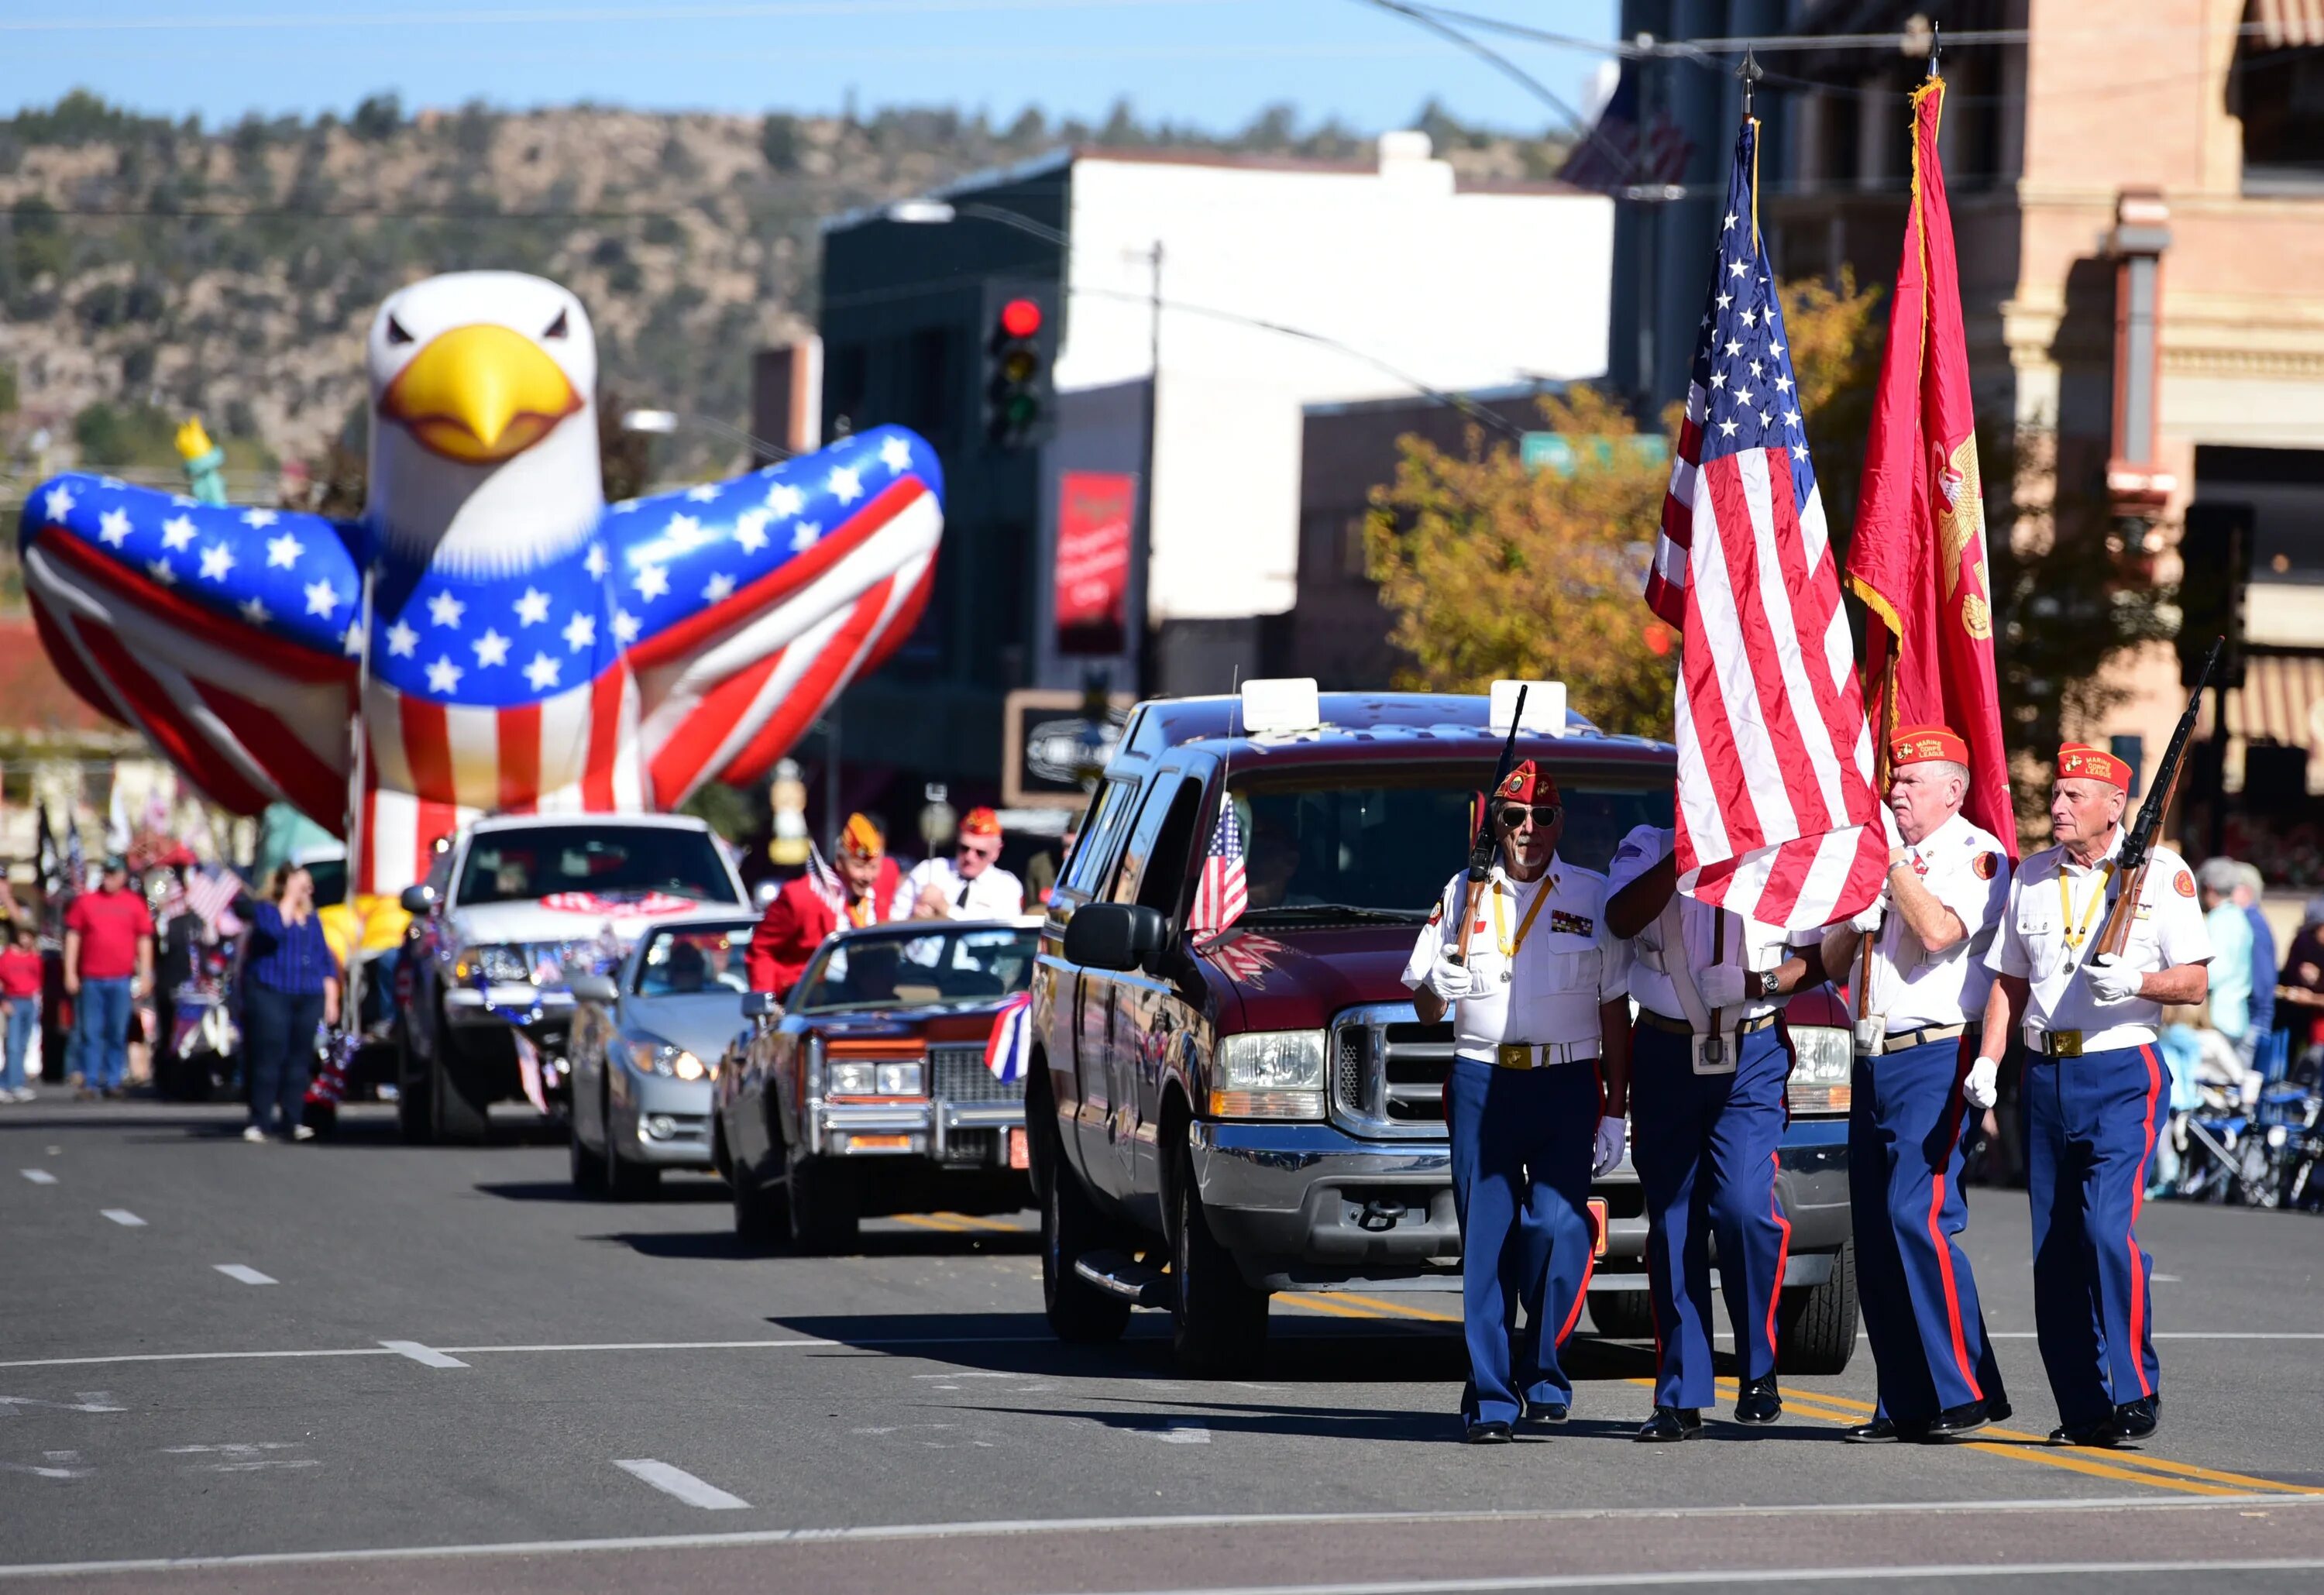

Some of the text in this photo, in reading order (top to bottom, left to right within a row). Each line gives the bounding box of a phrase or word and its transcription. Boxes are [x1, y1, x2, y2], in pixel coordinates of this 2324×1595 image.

[1916, 739, 1942, 748] MARINE
[2085, 757, 2112, 767] MARINE
[2088, 763, 2110, 772] CORPS
[2085, 768, 2112, 779] LEAGUE
